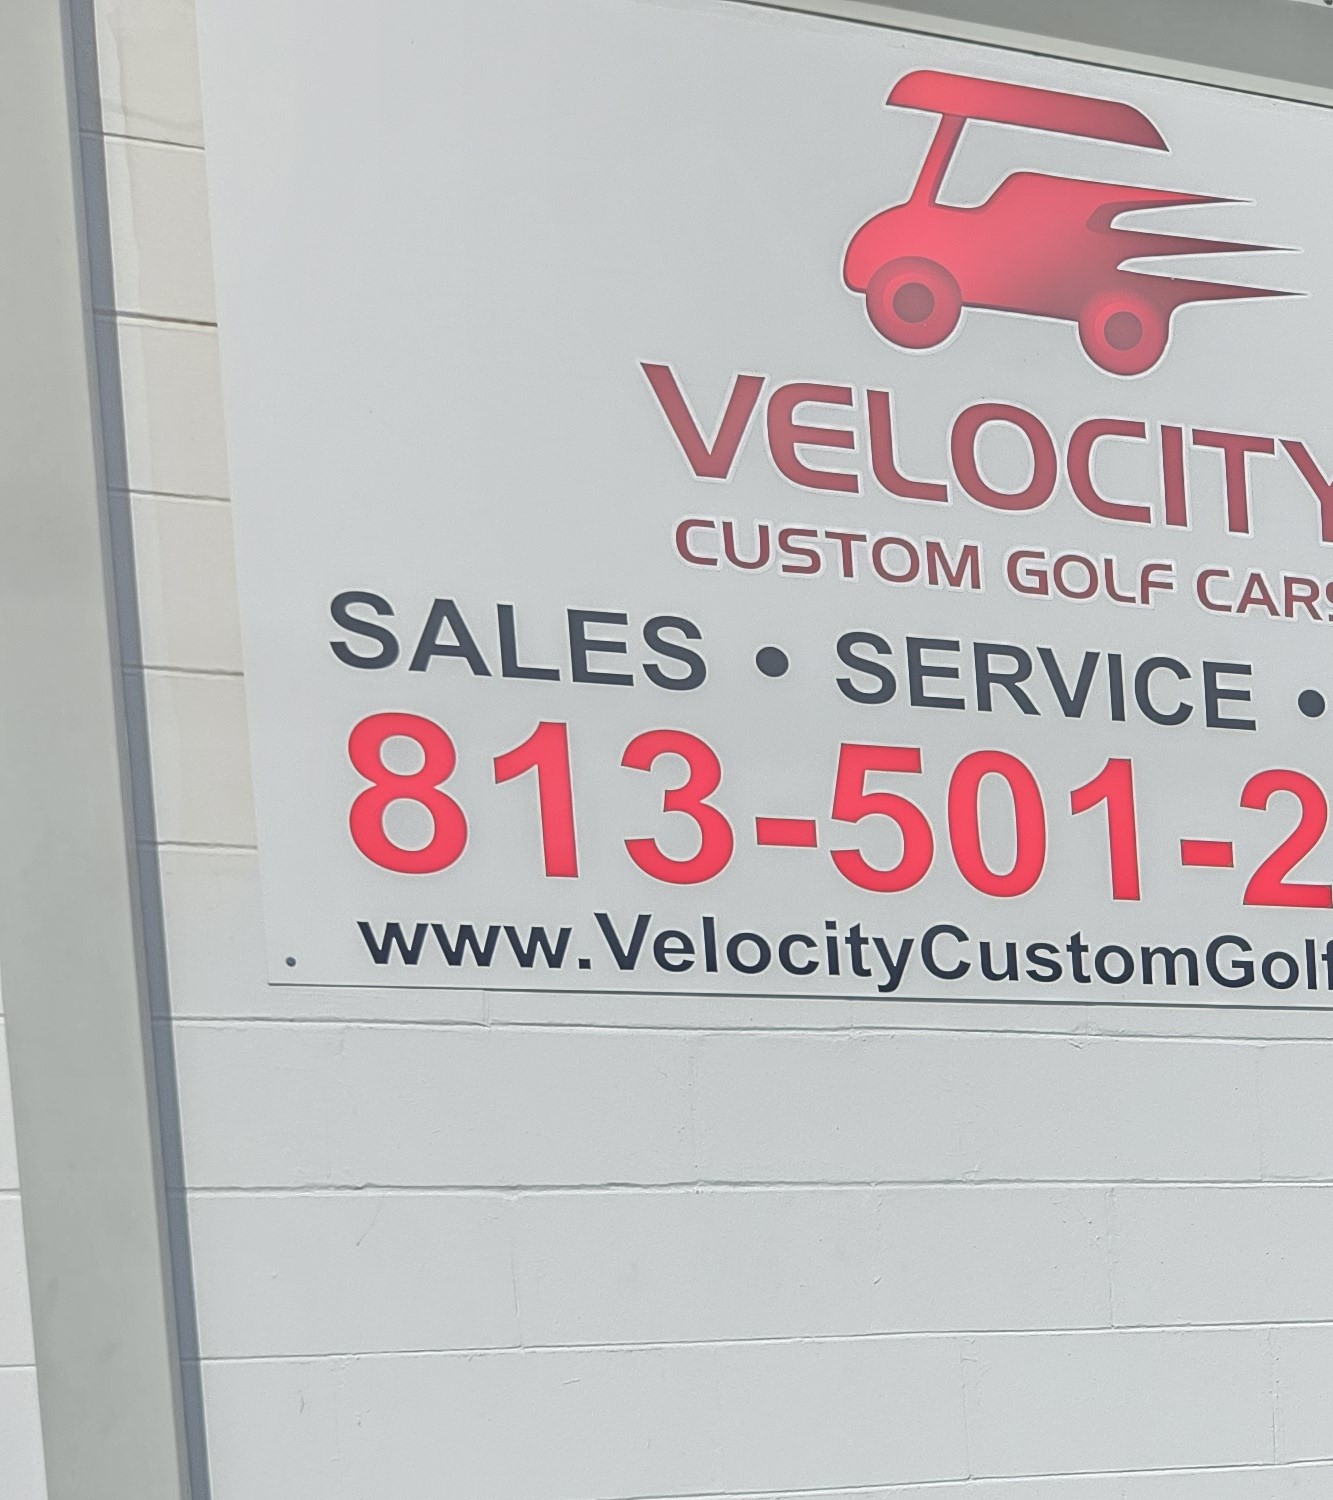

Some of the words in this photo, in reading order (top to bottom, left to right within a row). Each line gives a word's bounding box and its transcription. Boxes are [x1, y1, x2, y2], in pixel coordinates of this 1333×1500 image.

[674, 516, 984, 593] CUSTOM
[1004, 548, 1175, 606] GOLF
[330, 590, 707, 691] SALES
[836, 631, 1257, 731] SERVICE
